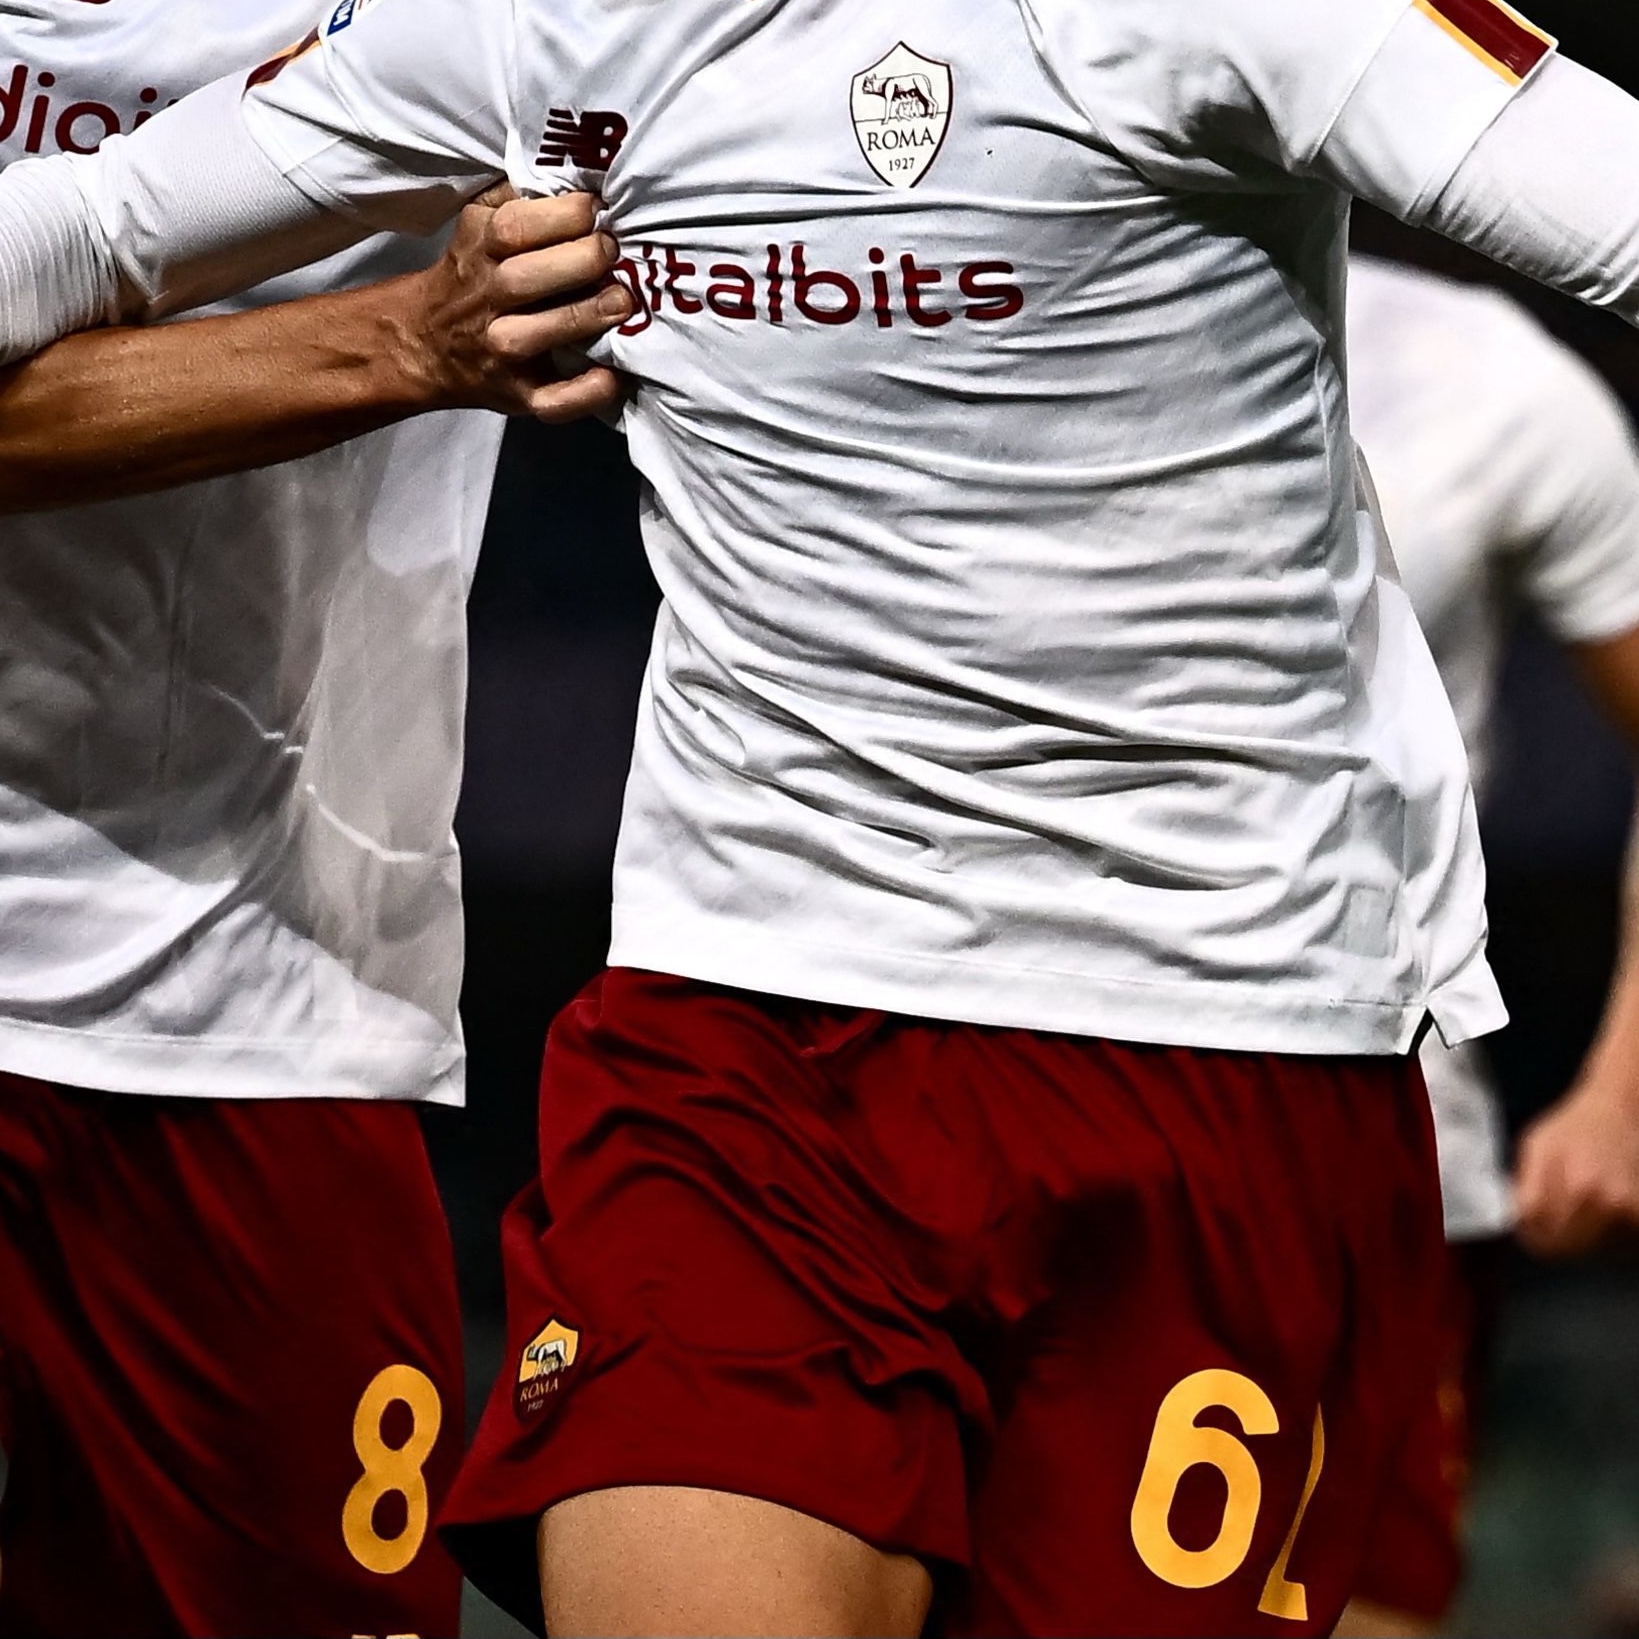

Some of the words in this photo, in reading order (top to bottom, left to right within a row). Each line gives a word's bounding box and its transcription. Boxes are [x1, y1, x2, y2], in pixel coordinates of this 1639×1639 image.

[867, 126, 936, 151] ROMA
[889, 157, 915, 171] 1927
[520, 1377, 559, 1403] ROMA
[342, 1364, 442, 1574] 8
